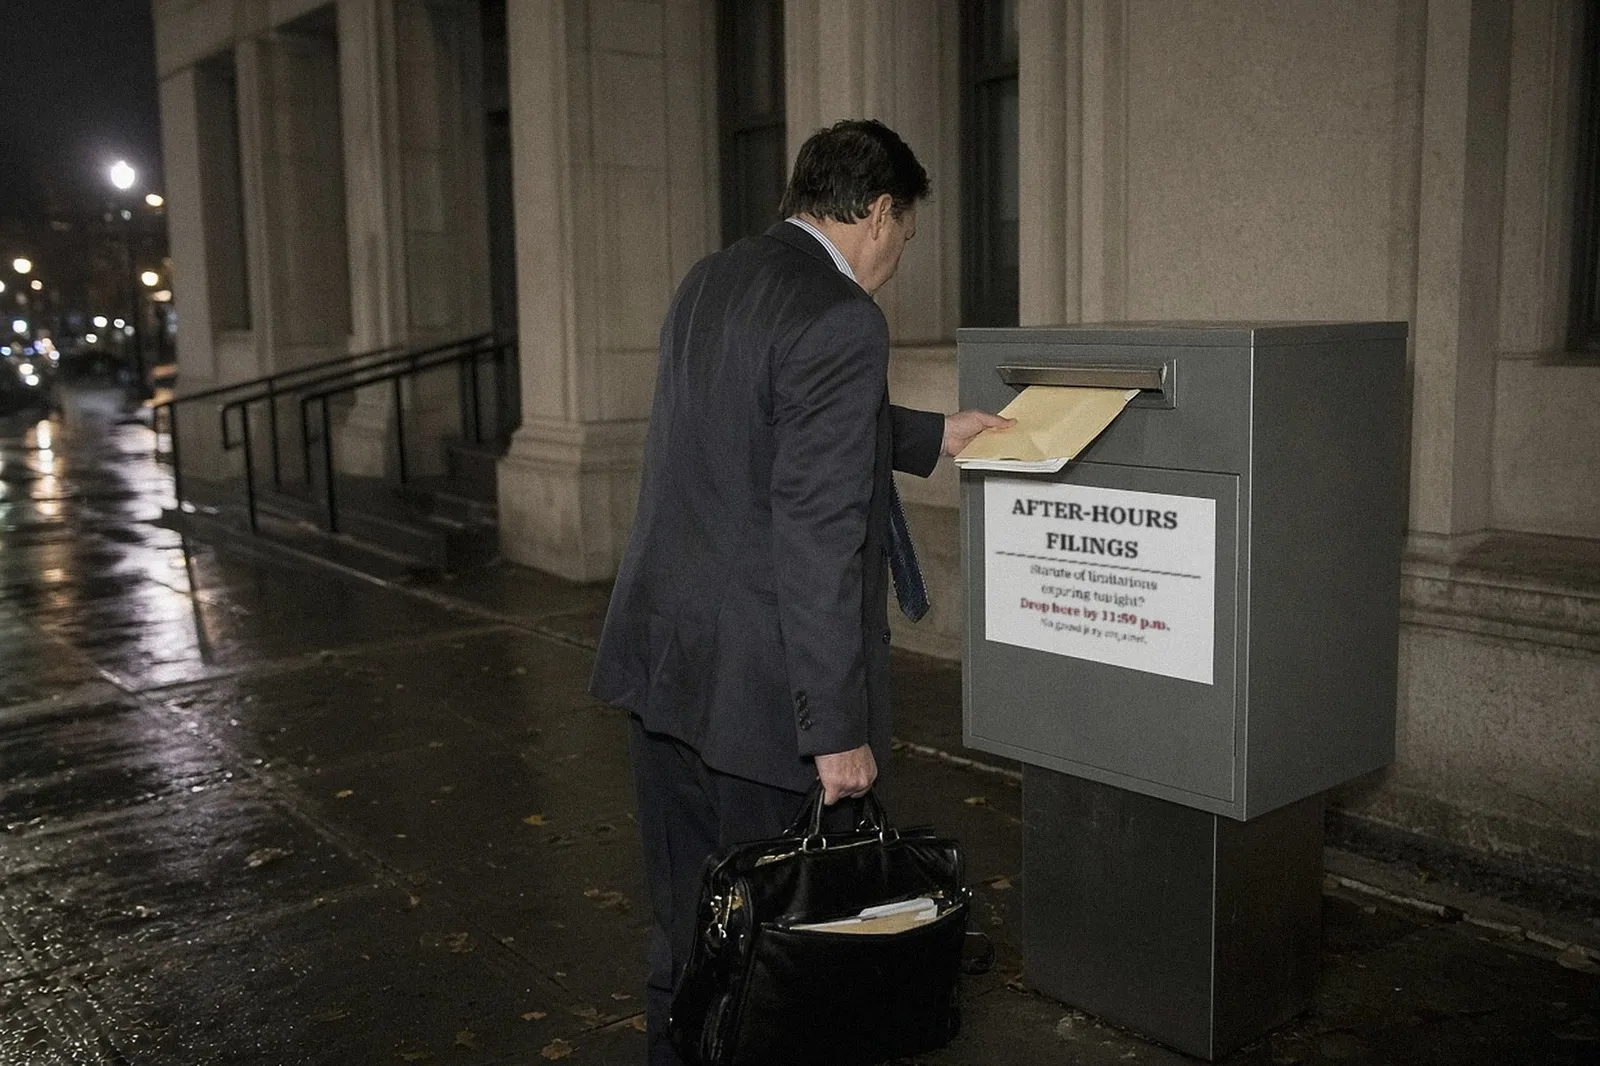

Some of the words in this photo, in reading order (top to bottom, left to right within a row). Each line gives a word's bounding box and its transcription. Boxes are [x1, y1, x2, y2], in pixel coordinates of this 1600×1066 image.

[1012, 499, 1178, 530] AFTER-HOURS
[1046, 532, 1139, 559] FILINGS
[1030, 564, 1071, 579] Statute
[1073, 569, 1086, 581] of
[1087, 570, 1158, 590] limitations
[1021, 597, 1050, 614] Drop
[1052, 602, 1080, 616] here
[1083, 606, 1098, 621] by
[1102, 610, 1138, 625] 11:59
[1140, 617, 1171, 632] p.m.
